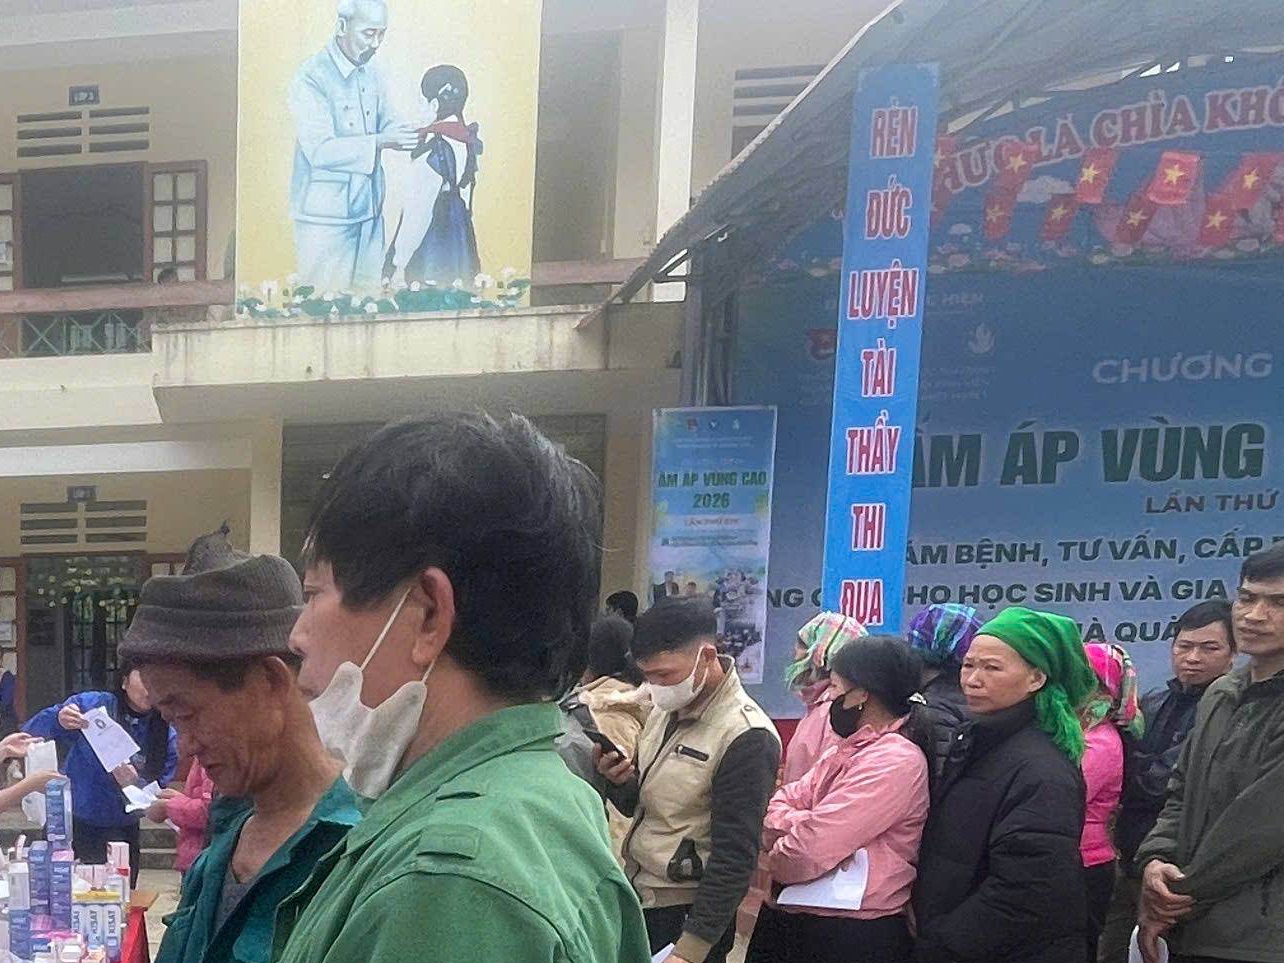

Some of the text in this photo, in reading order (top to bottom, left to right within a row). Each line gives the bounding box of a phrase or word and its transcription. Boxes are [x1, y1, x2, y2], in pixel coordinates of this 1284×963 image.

[1091, 89, 1198, 149] CHÌA
[865, 175, 912, 240] ĐỨC
[847, 258, 917, 329] LUYỆN
[1092, 351, 1273, 384] CHƯƠNG
[1000, 420, 1080, 486] ÁP
[1100, 416, 1265, 483] VÙNG
[1145, 488, 1279, 514] LẦN THỨ
[852, 503, 886, 551] THI
[955, 538, 1048, 568] BỆNH,
[1057, 538, 1102, 561] TƯ
[1108, 529, 1185, 564] VẤN,
[1194, 527, 1263, 558] CẤP
[840, 578, 883, 627] ĐUA
[959, 584, 1027, 610] HỌC
[1035, 581, 1111, 603] SINH
[1118, 576, 1162, 601] VÀ
[1171, 580, 1229, 600] GIA
